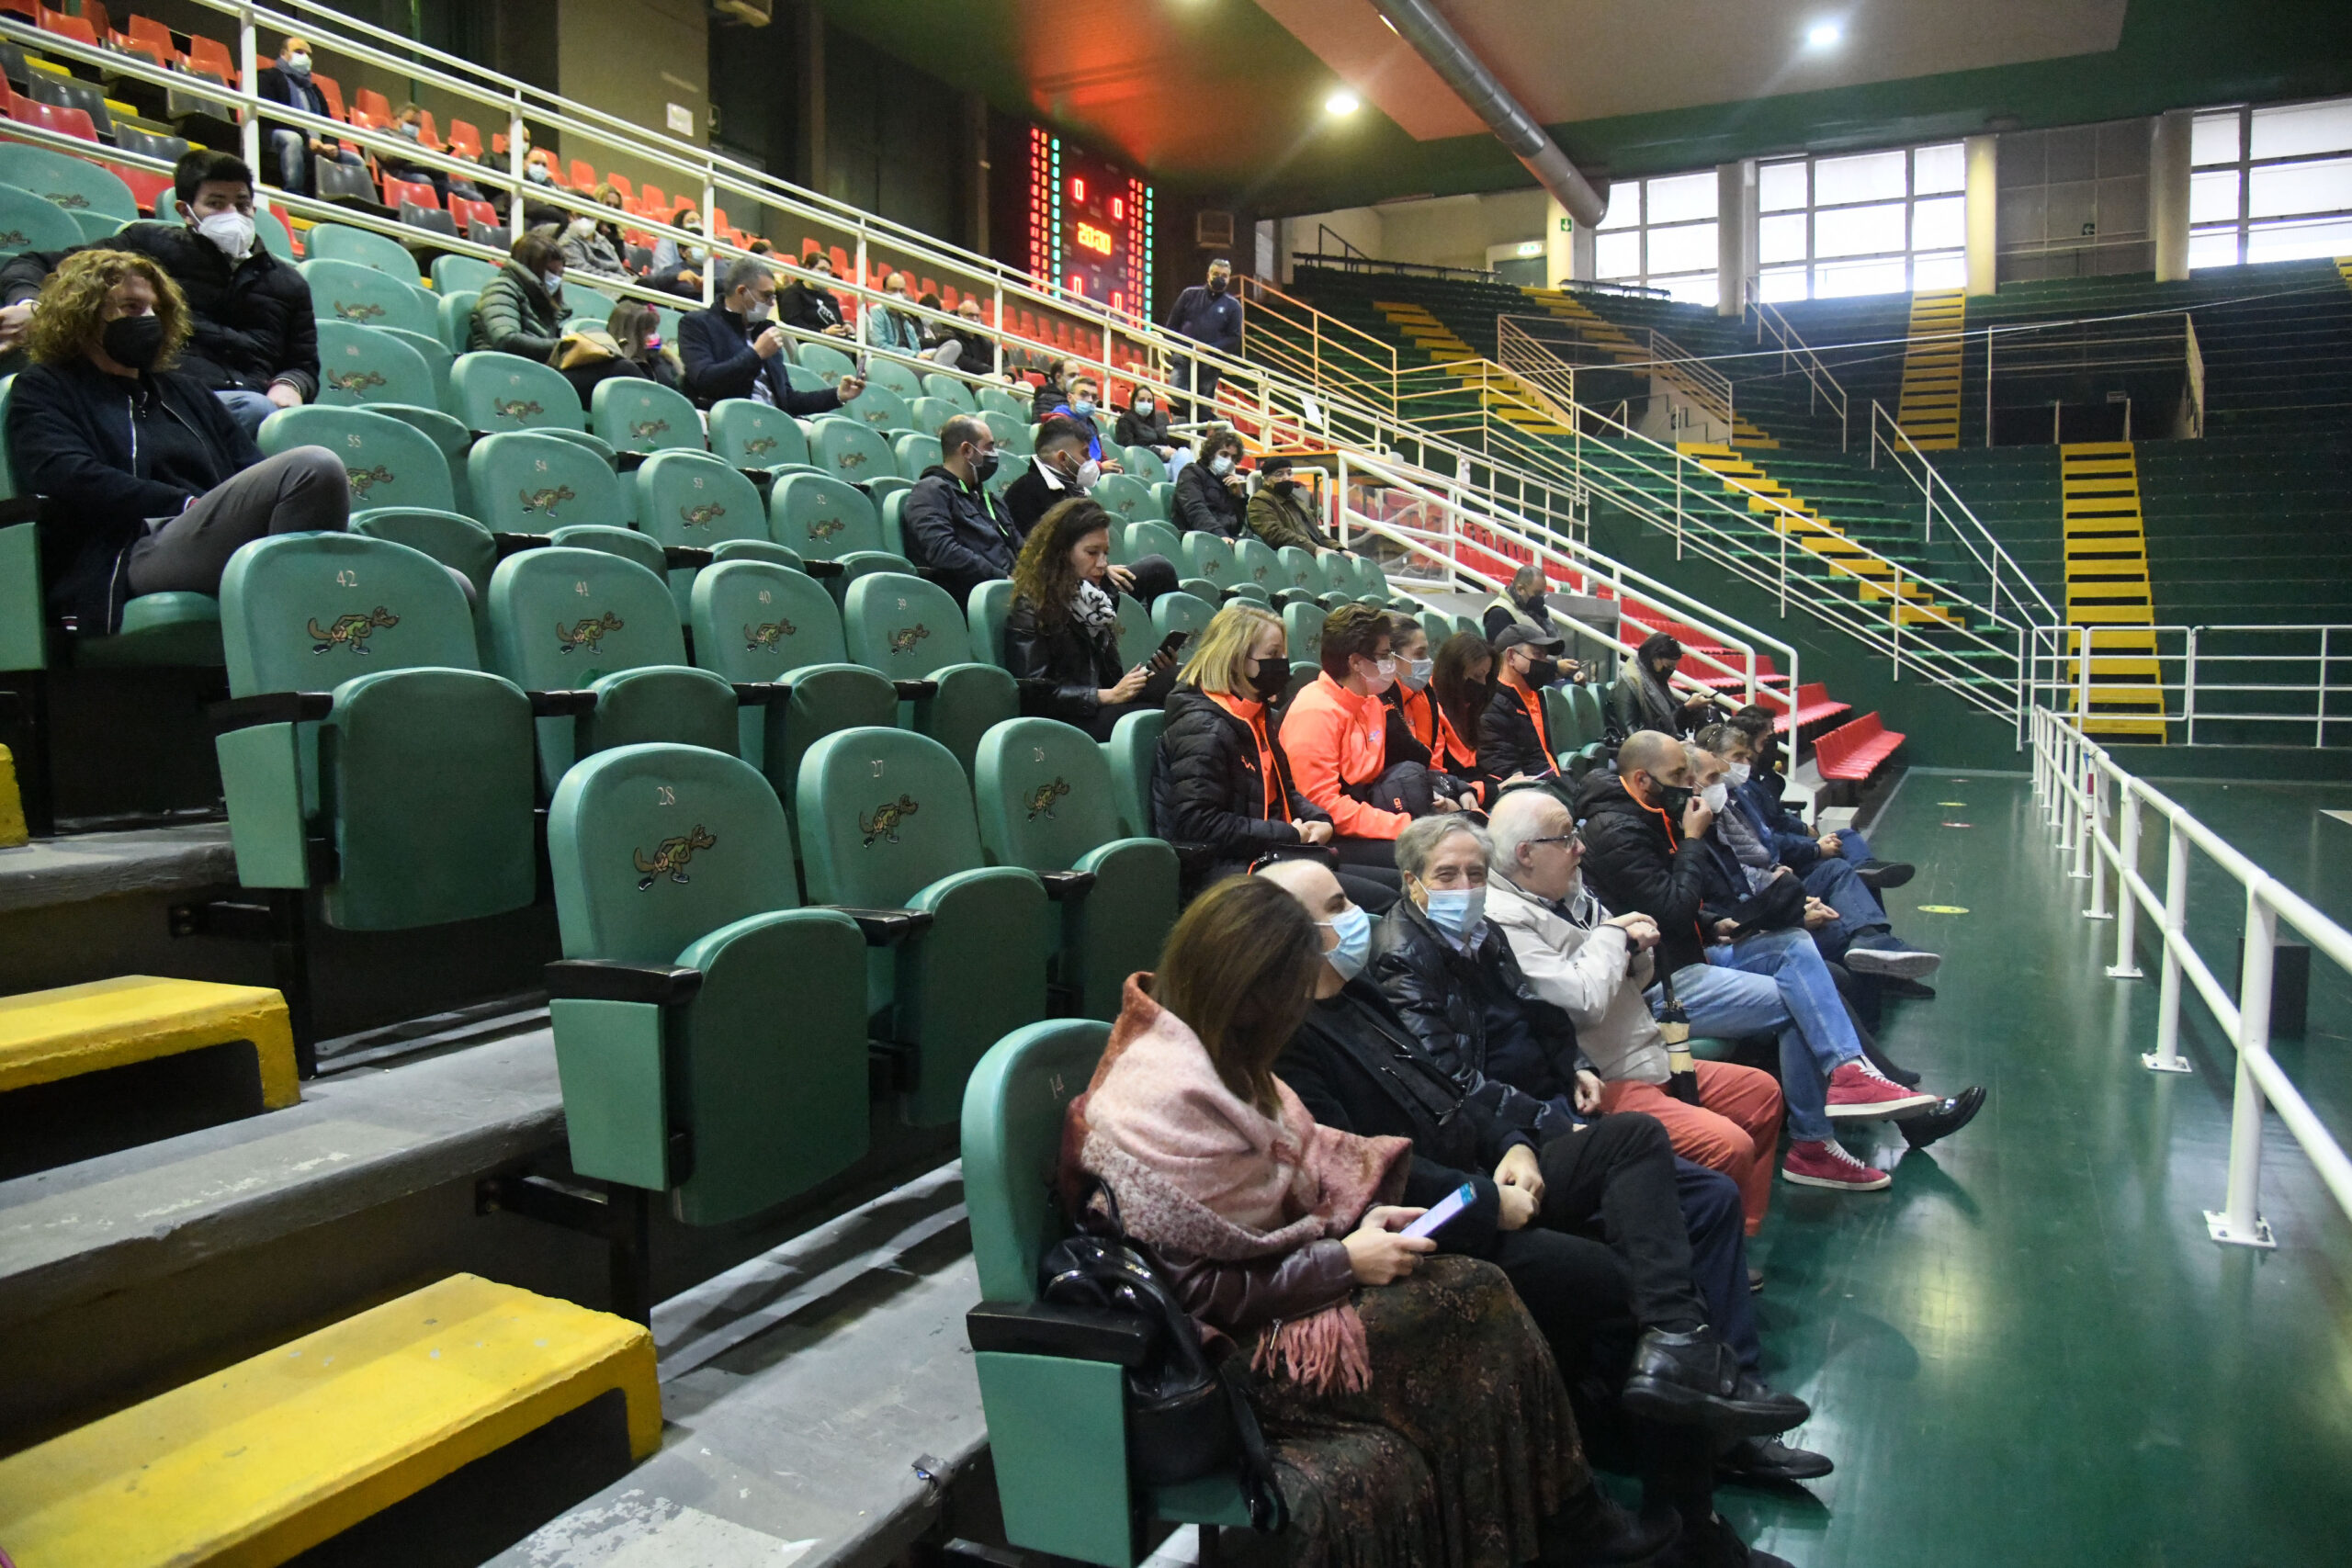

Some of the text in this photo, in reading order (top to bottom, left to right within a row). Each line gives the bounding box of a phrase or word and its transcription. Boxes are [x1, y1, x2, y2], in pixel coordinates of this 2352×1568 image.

[1074, 178, 1084, 202] 0
[1114, 197, 1124, 220] 0
[347, 434, 362, 448] 55
[535, 459, 547, 472] 54
[693, 476, 704, 490] 53
[336, 570, 358, 588] 42
[574, 581, 589, 598] 41
[758, 590, 772, 604] 40
[897, 597, 907, 611] 39
[1033, 747, 1045, 763] 26
[871, 760, 883, 780] 27
[657, 785, 675, 807] 28
[1049, 1074, 1065, 1099] 14
